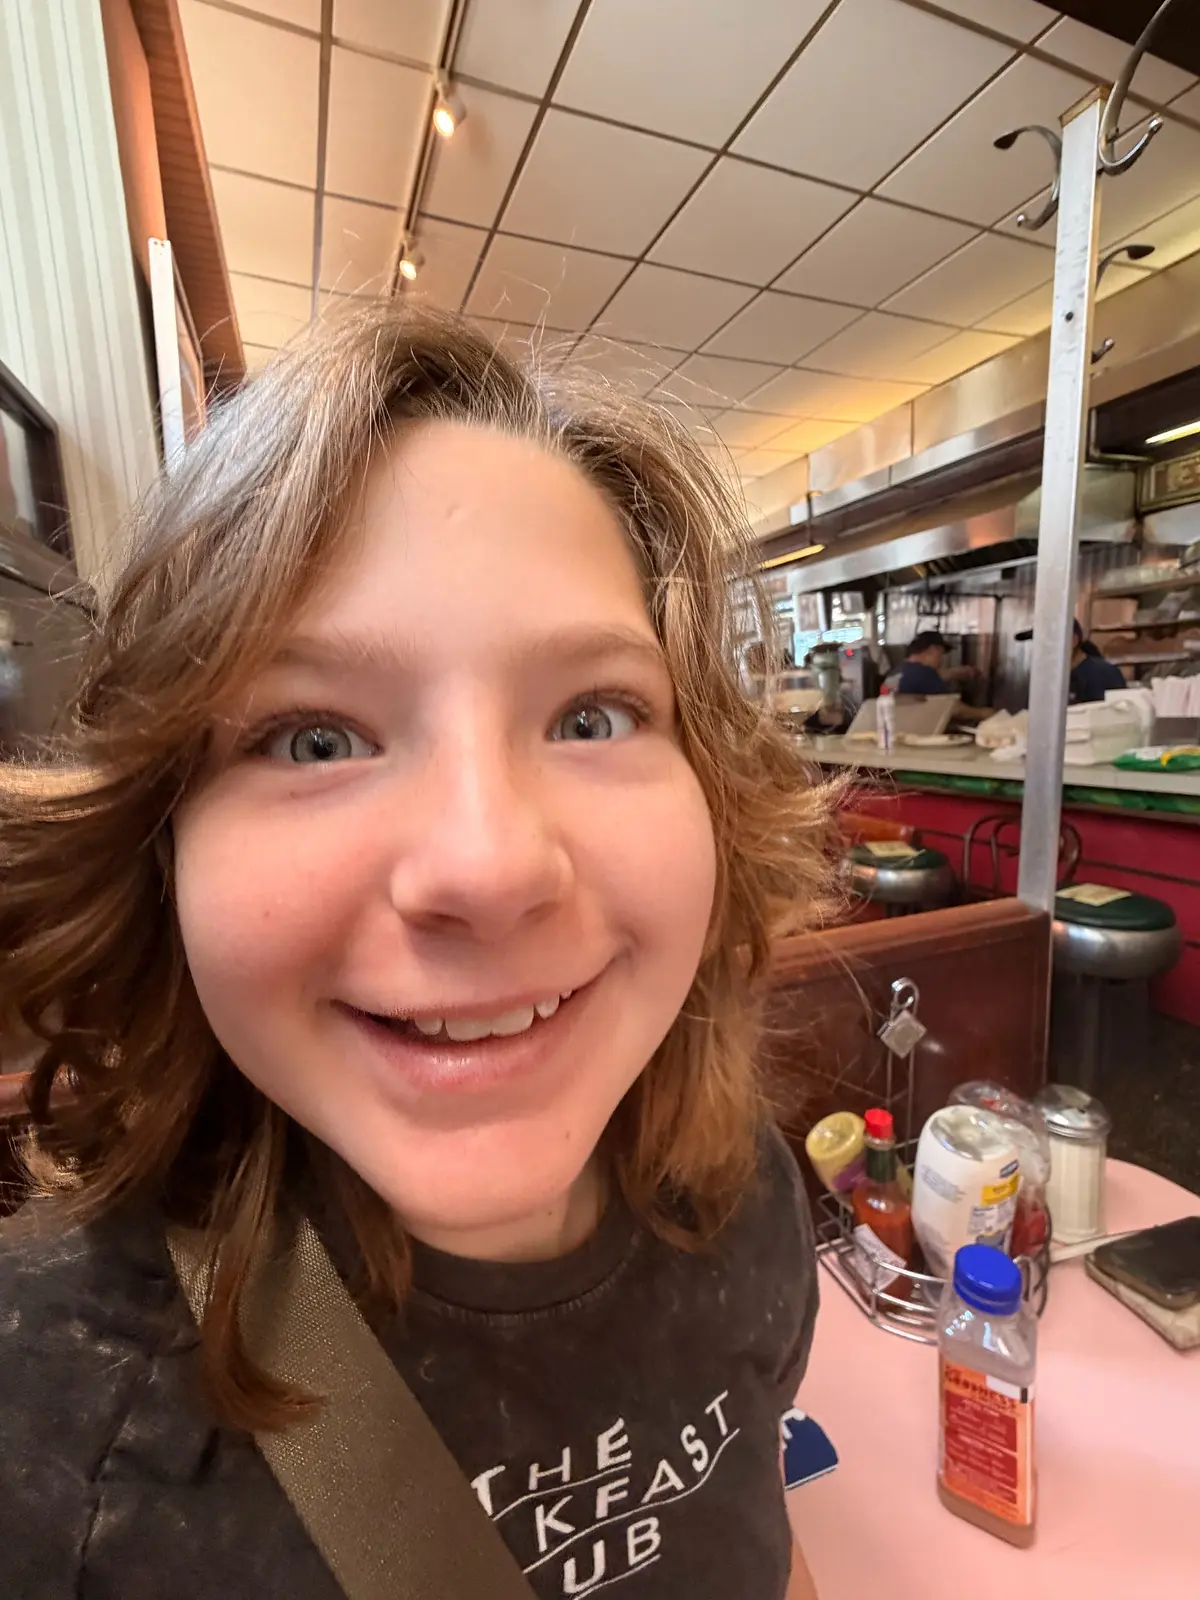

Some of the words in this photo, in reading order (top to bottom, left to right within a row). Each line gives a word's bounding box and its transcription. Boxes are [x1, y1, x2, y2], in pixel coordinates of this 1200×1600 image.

[470, 1418, 632, 1516] THE
[534, 1390, 729, 1552] KFAST
[562, 1516, 662, 1594] UB
